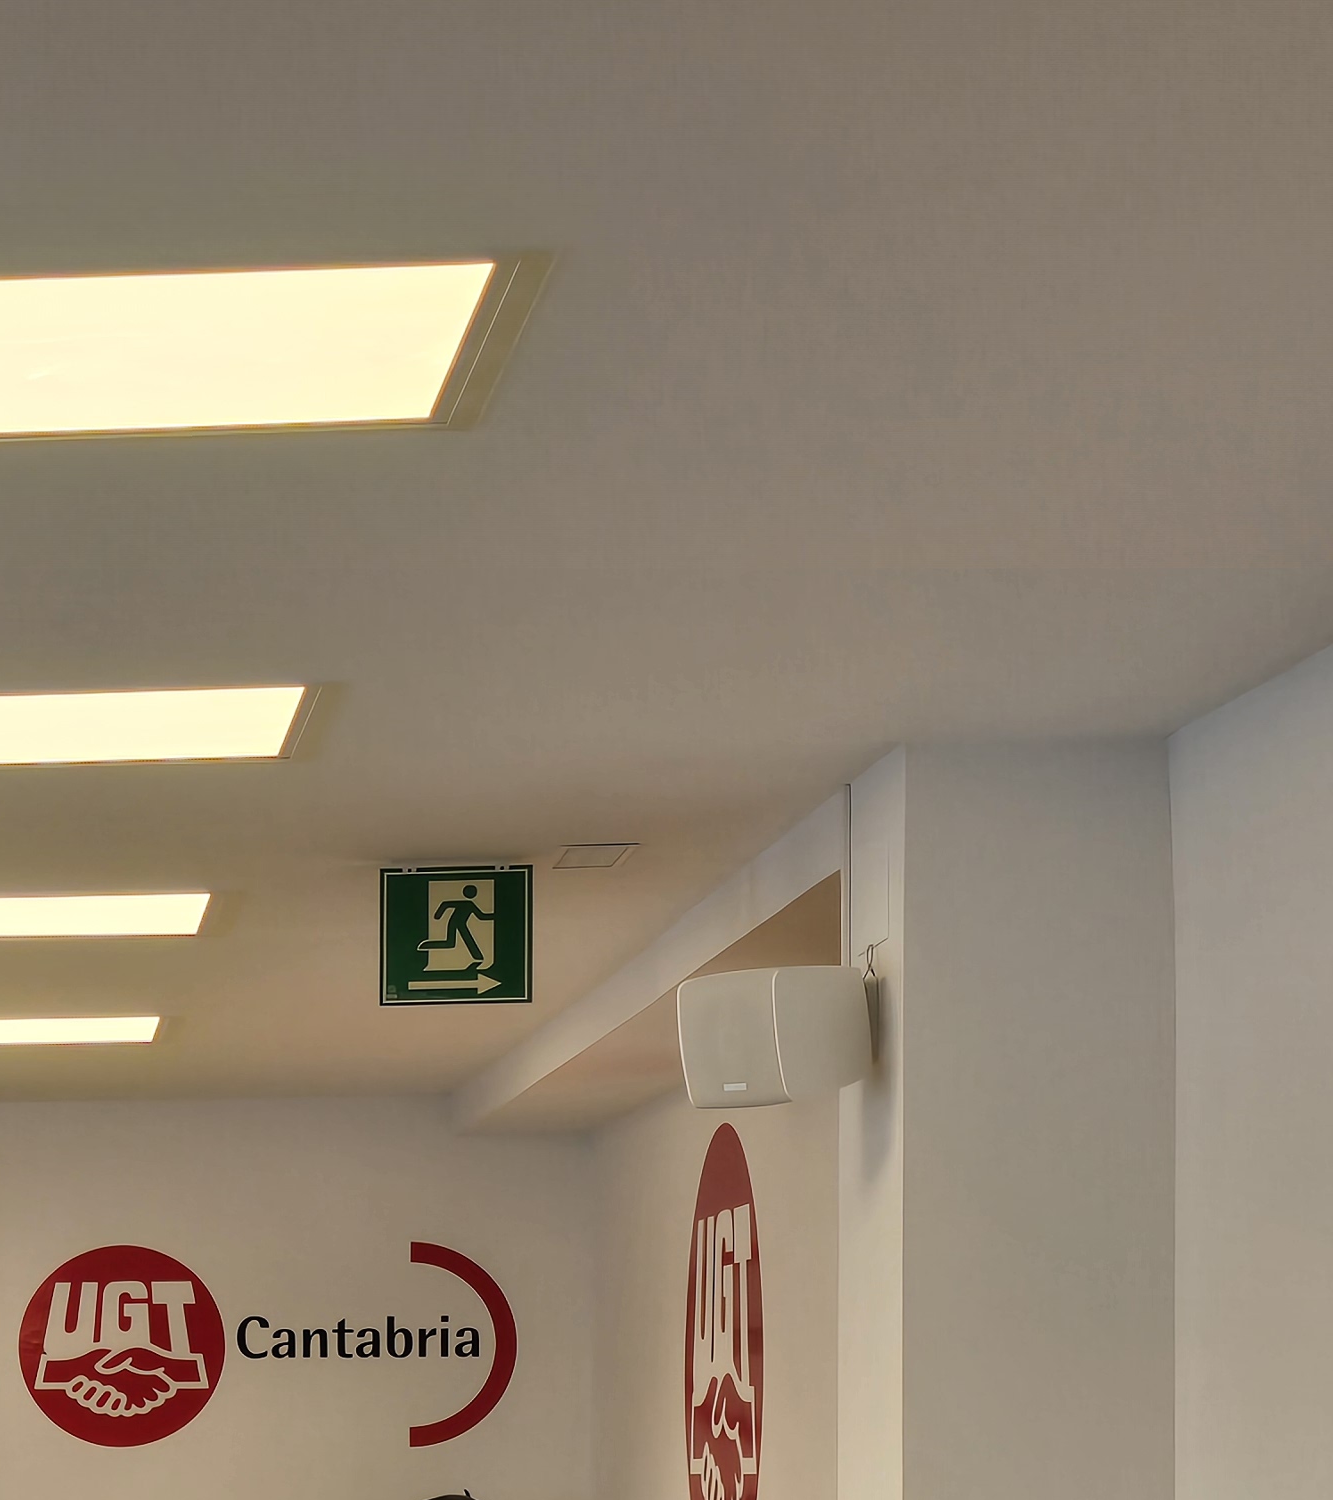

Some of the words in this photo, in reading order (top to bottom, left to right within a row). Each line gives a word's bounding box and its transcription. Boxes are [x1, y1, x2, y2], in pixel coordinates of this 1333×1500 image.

[44, 1281, 196, 1358] UGT
[236, 1315, 481, 1360] Cantabria
[694, 1203, 753, 1392] UGT
